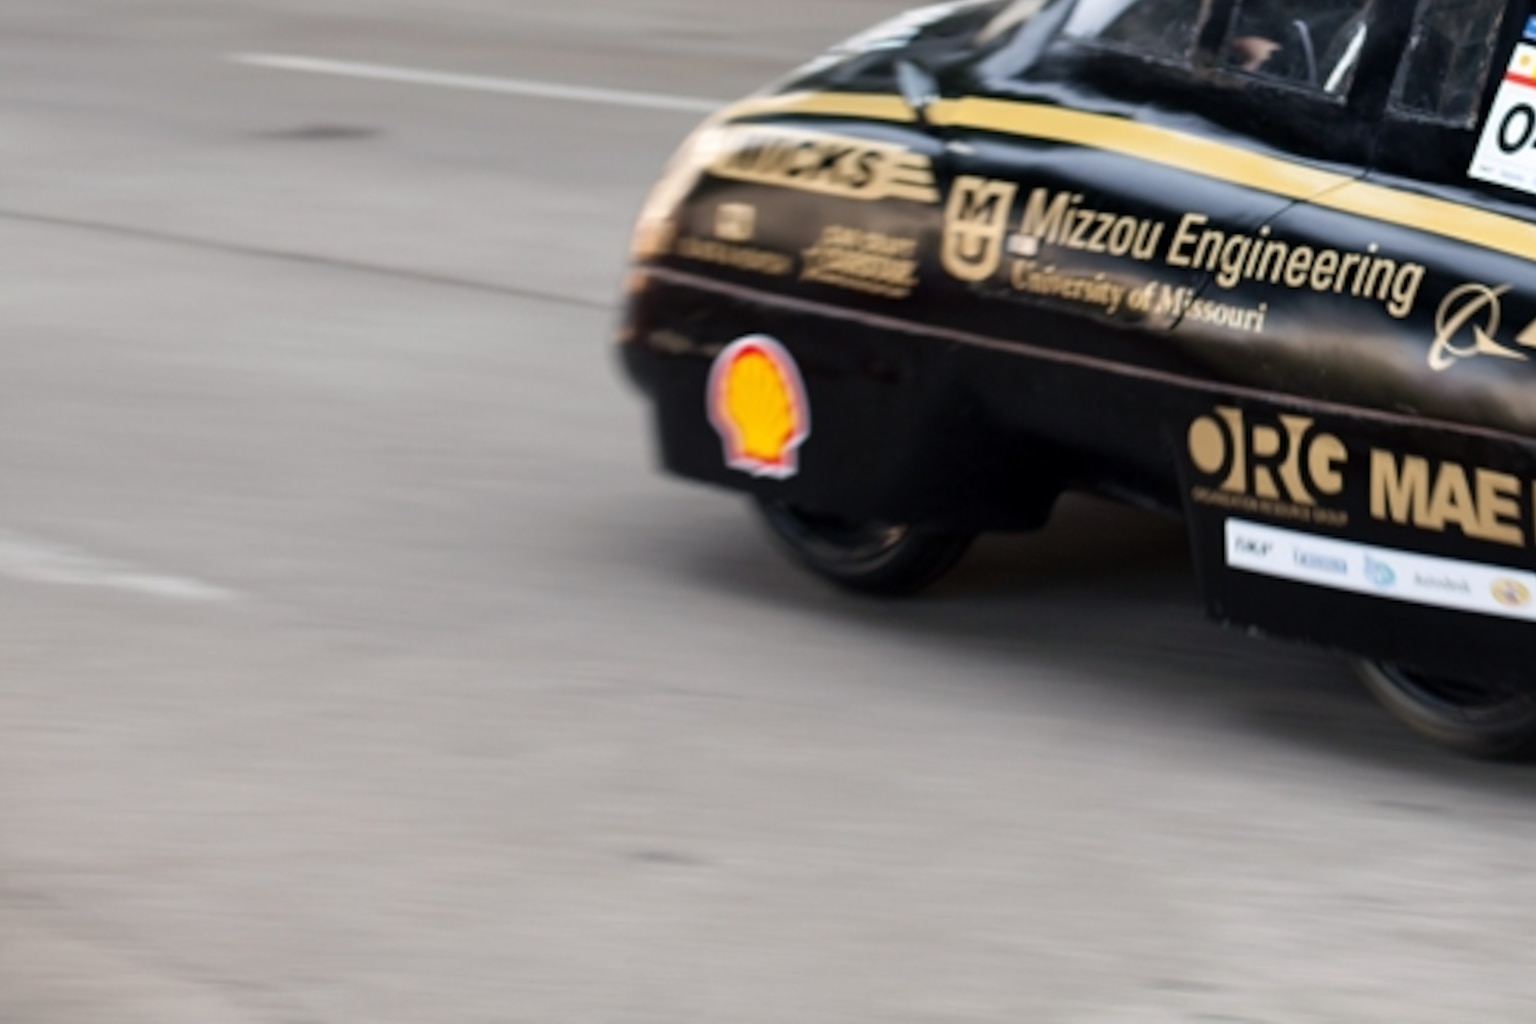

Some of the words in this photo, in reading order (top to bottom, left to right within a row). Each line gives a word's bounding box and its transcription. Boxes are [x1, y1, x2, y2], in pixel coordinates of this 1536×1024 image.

[1010, 259, 1125, 315] University
[1127, 281, 1156, 311] of
[1155, 286, 1269, 334] Missouri
[1019, 187, 1165, 261] Mizzou
[1166, 212, 1426, 319] Engineering
[1369, 447, 1525, 547] MAE
